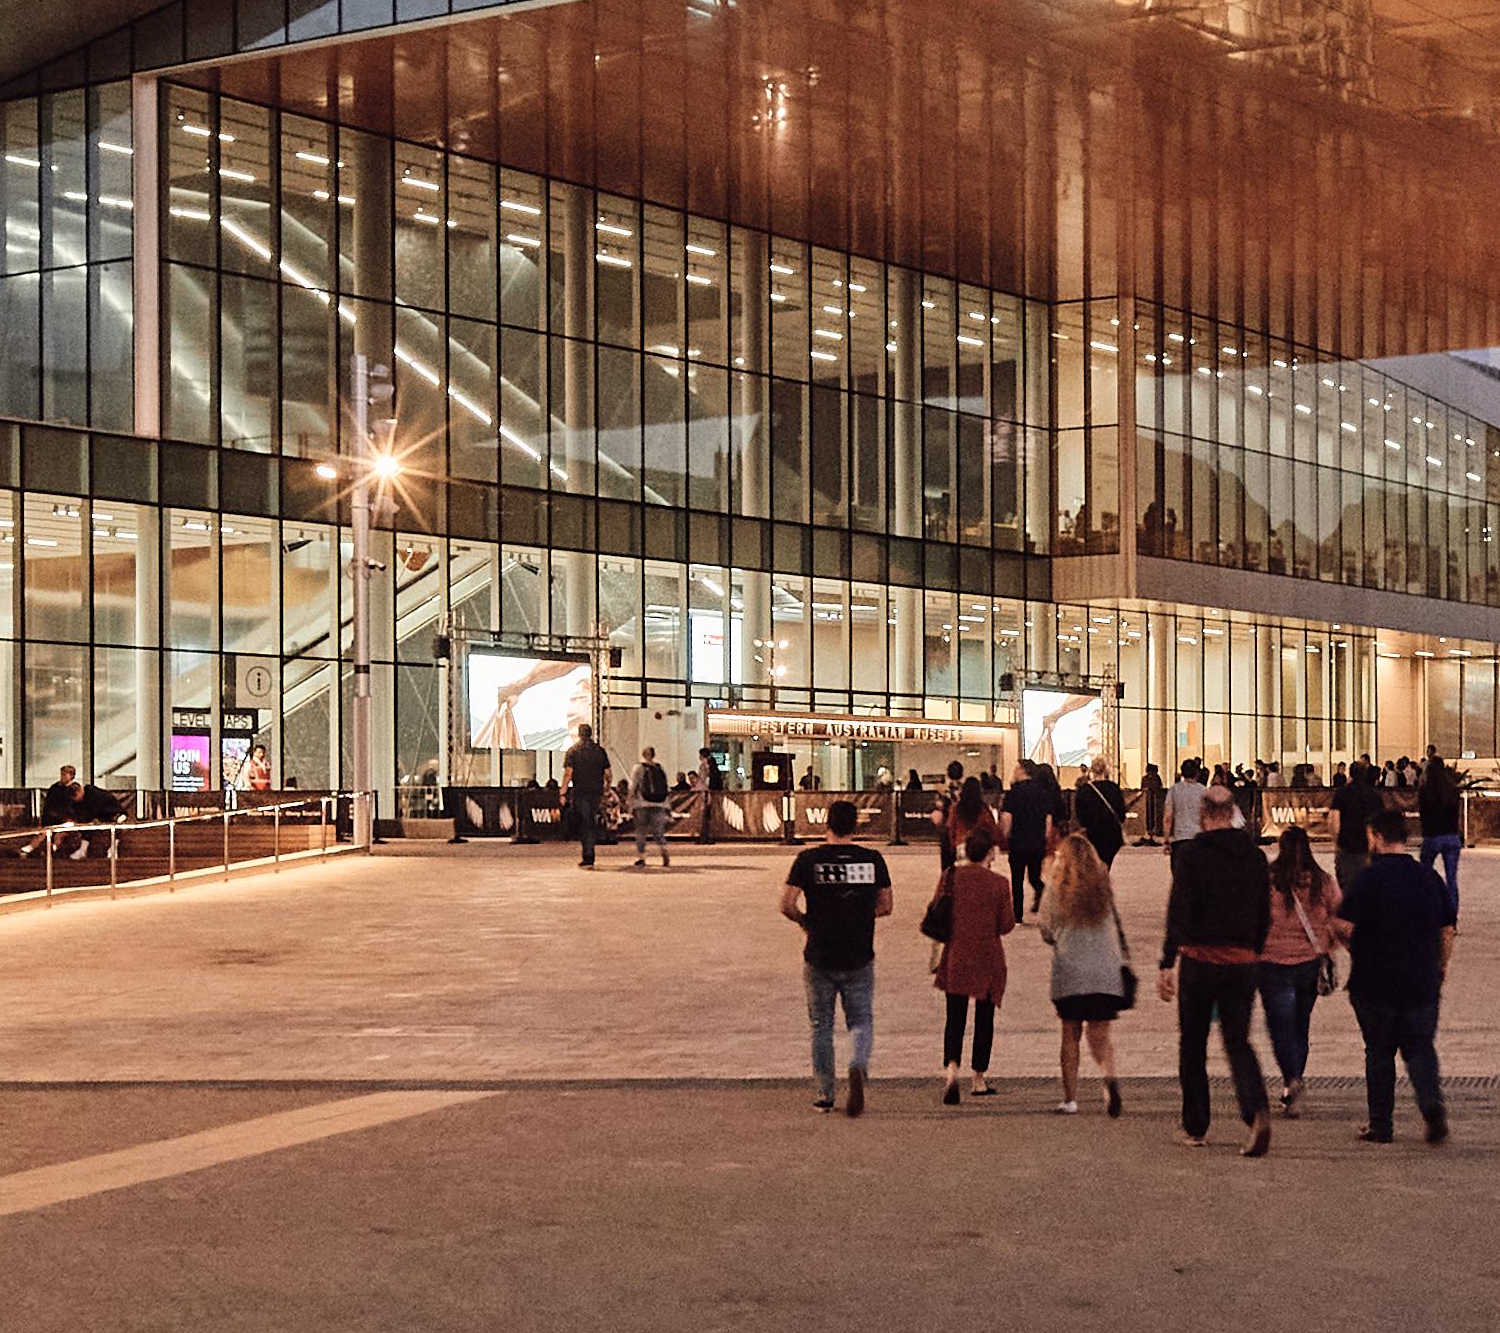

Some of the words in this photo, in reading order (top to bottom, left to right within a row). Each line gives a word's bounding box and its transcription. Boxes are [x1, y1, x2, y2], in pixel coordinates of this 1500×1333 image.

[173, 713, 209, 727] LEVEL
[225, 714, 249, 728] APS
[826, 723, 906, 739] AUSTRALIAN
[173, 749, 200, 763] JOIN
[173, 762, 191, 775] US
